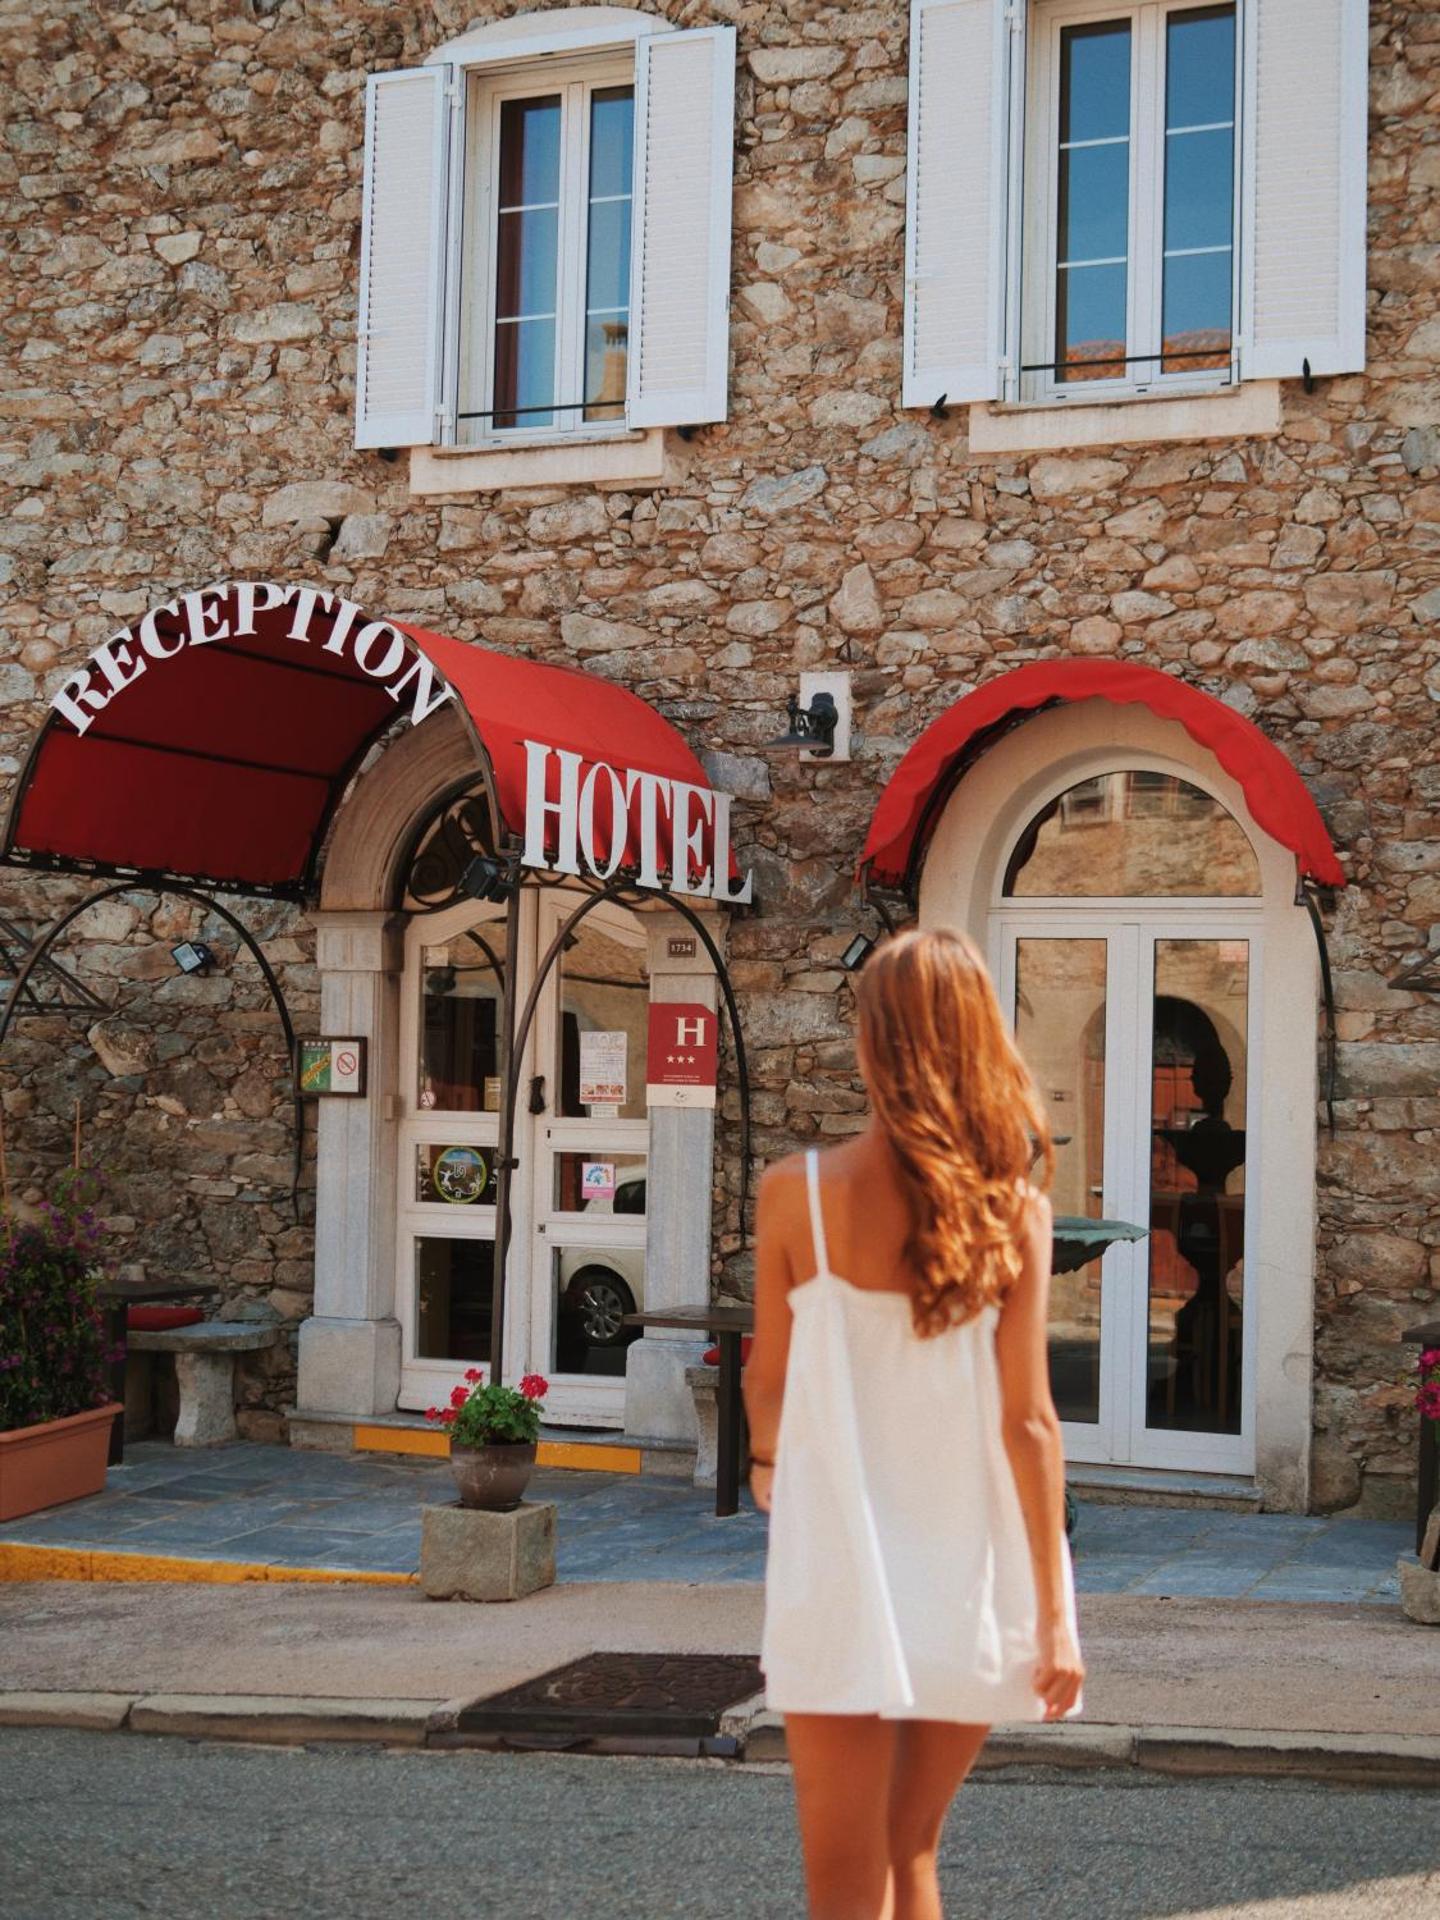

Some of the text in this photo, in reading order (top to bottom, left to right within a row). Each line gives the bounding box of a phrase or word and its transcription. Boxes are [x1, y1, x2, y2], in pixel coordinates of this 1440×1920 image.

[50, 581, 458, 737] RECEPTION
[520, 739, 752, 904] HOTEL
[675, 1017, 708, 1047] H
